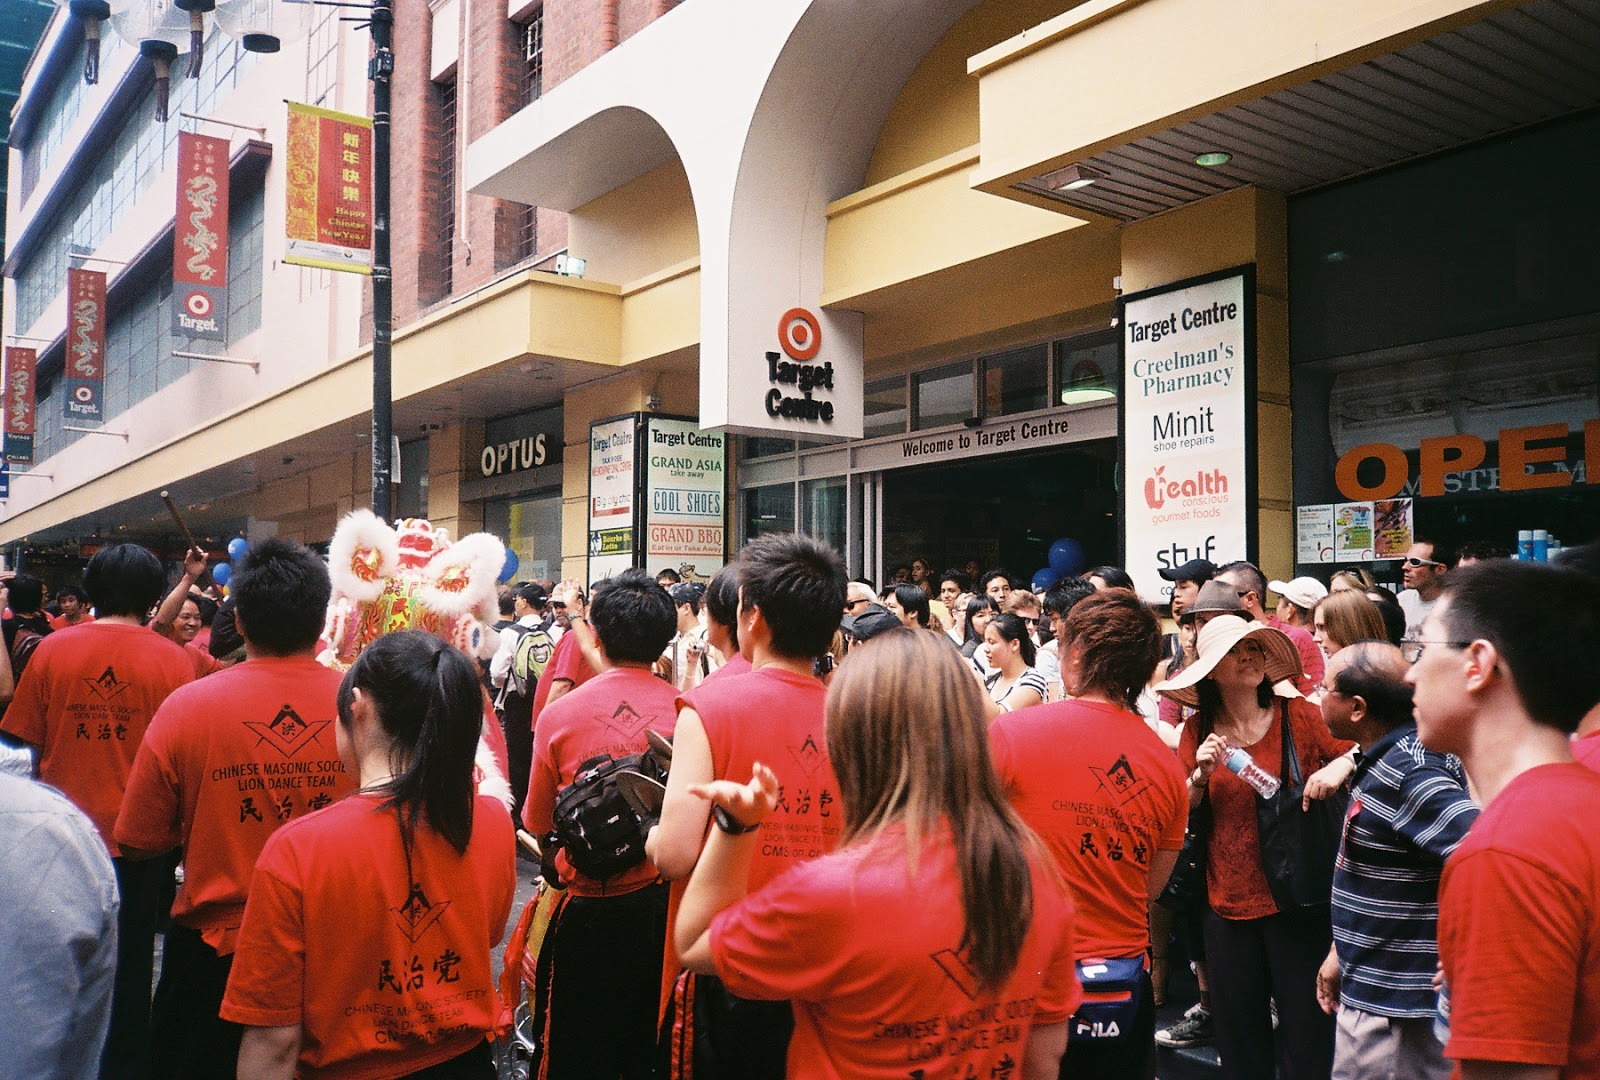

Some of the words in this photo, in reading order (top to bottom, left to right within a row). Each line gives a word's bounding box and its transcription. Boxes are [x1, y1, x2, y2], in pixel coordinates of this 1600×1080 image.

[342, 132, 360, 202] 新年快樂
[335, 206, 366, 218] Happy
[328, 218, 366, 230] Chinese
[1128, 312, 1177, 343] Target
[1182, 302, 1237, 331] Centre
[1133, 342, 1234, 378] Creelman's
[765, 351, 834, 391] Target
[1143, 366, 1234, 397] Pharmacy
[765, 388, 834, 423] Centre
[1153, 406, 1214, 441] Minit
[651, 429, 685, 447] Target
[688, 431, 722, 449] Centre
[902, 438, 953, 458] Welcome
[959, 434, 970, 449] to
[975, 425, 1016, 445] Target
[1021, 419, 1069, 439] Centre
[1153, 439, 1177, 452] shoe
[1180, 435, 1215, 449] repairs
[481, 432, 546, 477] OPTUS
[1335, 418, 1600, 501] OPE
[651, 456, 693, 470] GRAND
[696, 459, 722, 472] ASIA
[670, 469, 685, 477] take
[687, 471, 705, 479] away
[654, 491, 681, 512] COOL
[687, 492, 721, 514] SHOES
[1182, 495, 1228, 507] conscious
[1152, 511, 1190, 526] gourmet
[1193, 508, 1221, 518] foods
[651, 527, 694, 543] GRAND
[698, 529, 722, 545] BBQ
[603, 543, 619, 551] Lotto
[702, 545, 722, 553] Away
[212, 763, 259, 782] CHINESE
[263, 761, 314, 775] MASONIC
[237, 778, 265, 792] LION
[268, 776, 303, 790] DANCE
[306, 775, 336, 788] TEAM
[1052, 800, 1094, 815] CHINESE
[1076, 815, 1099, 827] LION
[378, 949, 462, 995] 民治党
[344, 1003, 394, 1017] CHINESE
[1076, 1020, 1120, 1038] FILA
